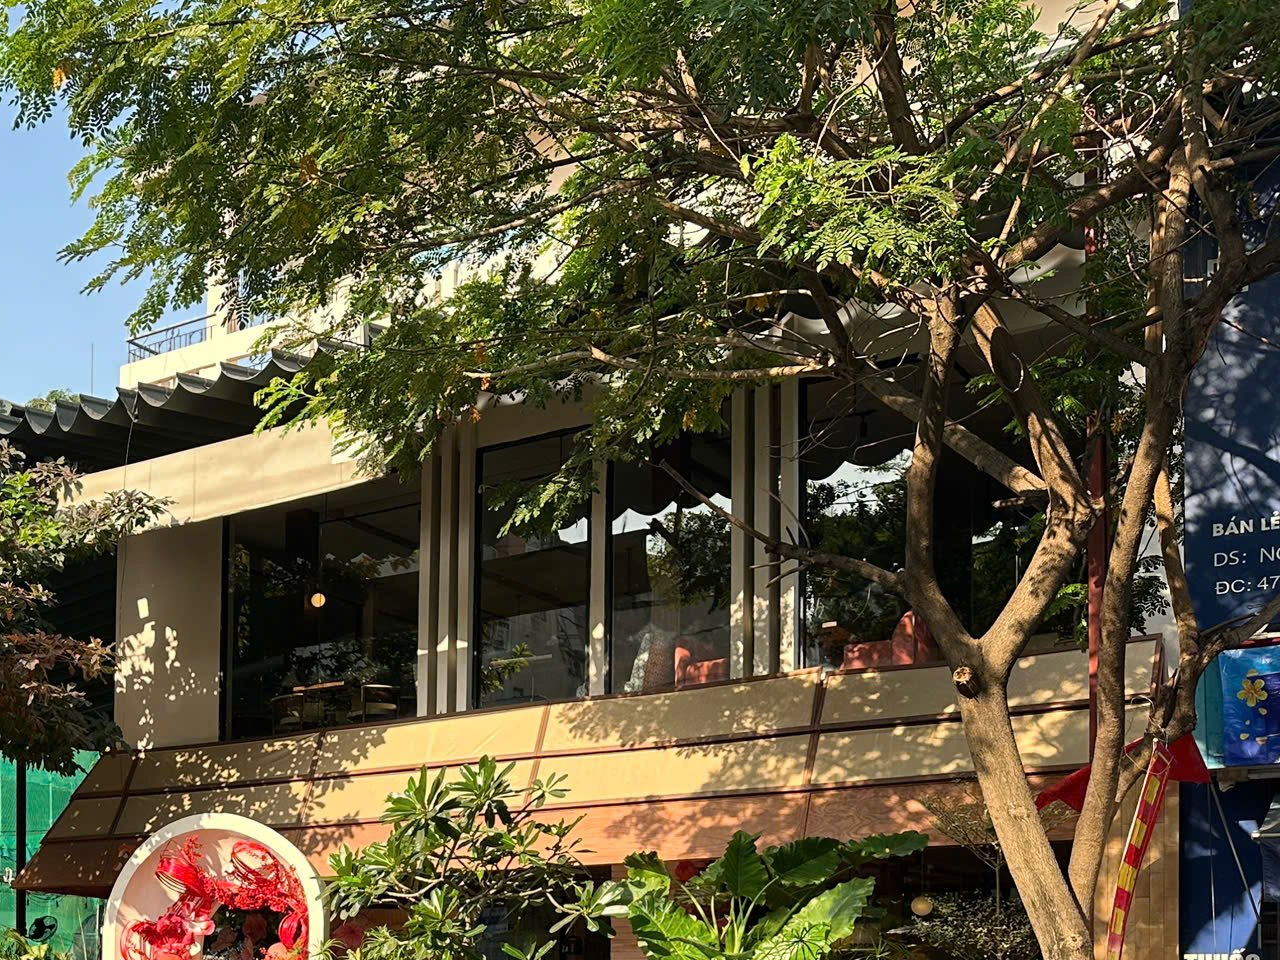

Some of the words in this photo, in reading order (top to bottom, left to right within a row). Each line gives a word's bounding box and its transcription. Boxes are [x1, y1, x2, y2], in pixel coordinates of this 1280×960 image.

[1212, 515, 1254, 537] BÁN
[1214, 550, 1247, 567] DS:
[1214, 579, 1251, 595] ĐC:
